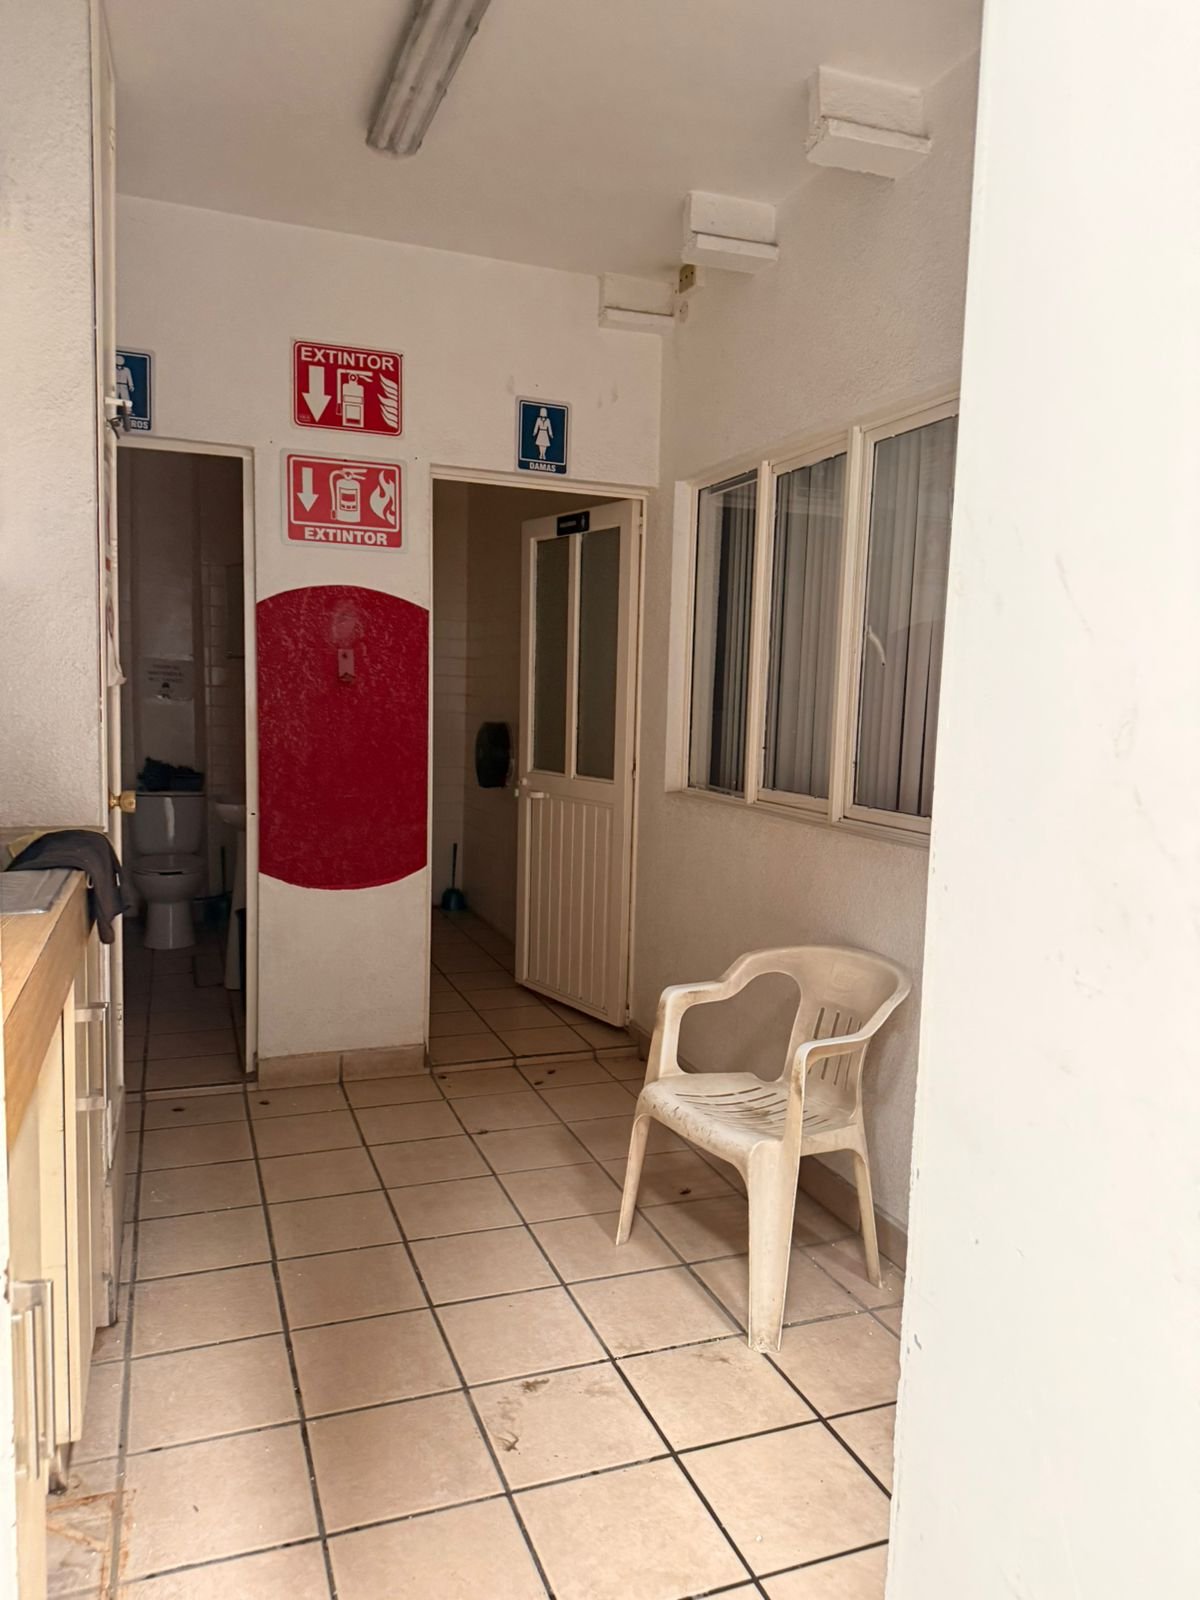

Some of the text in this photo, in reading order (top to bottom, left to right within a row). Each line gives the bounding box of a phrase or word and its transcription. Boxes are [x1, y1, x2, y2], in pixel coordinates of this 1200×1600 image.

[300, 346, 395, 372] EXTINTOR
[529, 461, 557, 473] DAMAS
[304, 526, 388, 546] EXTINTOR
